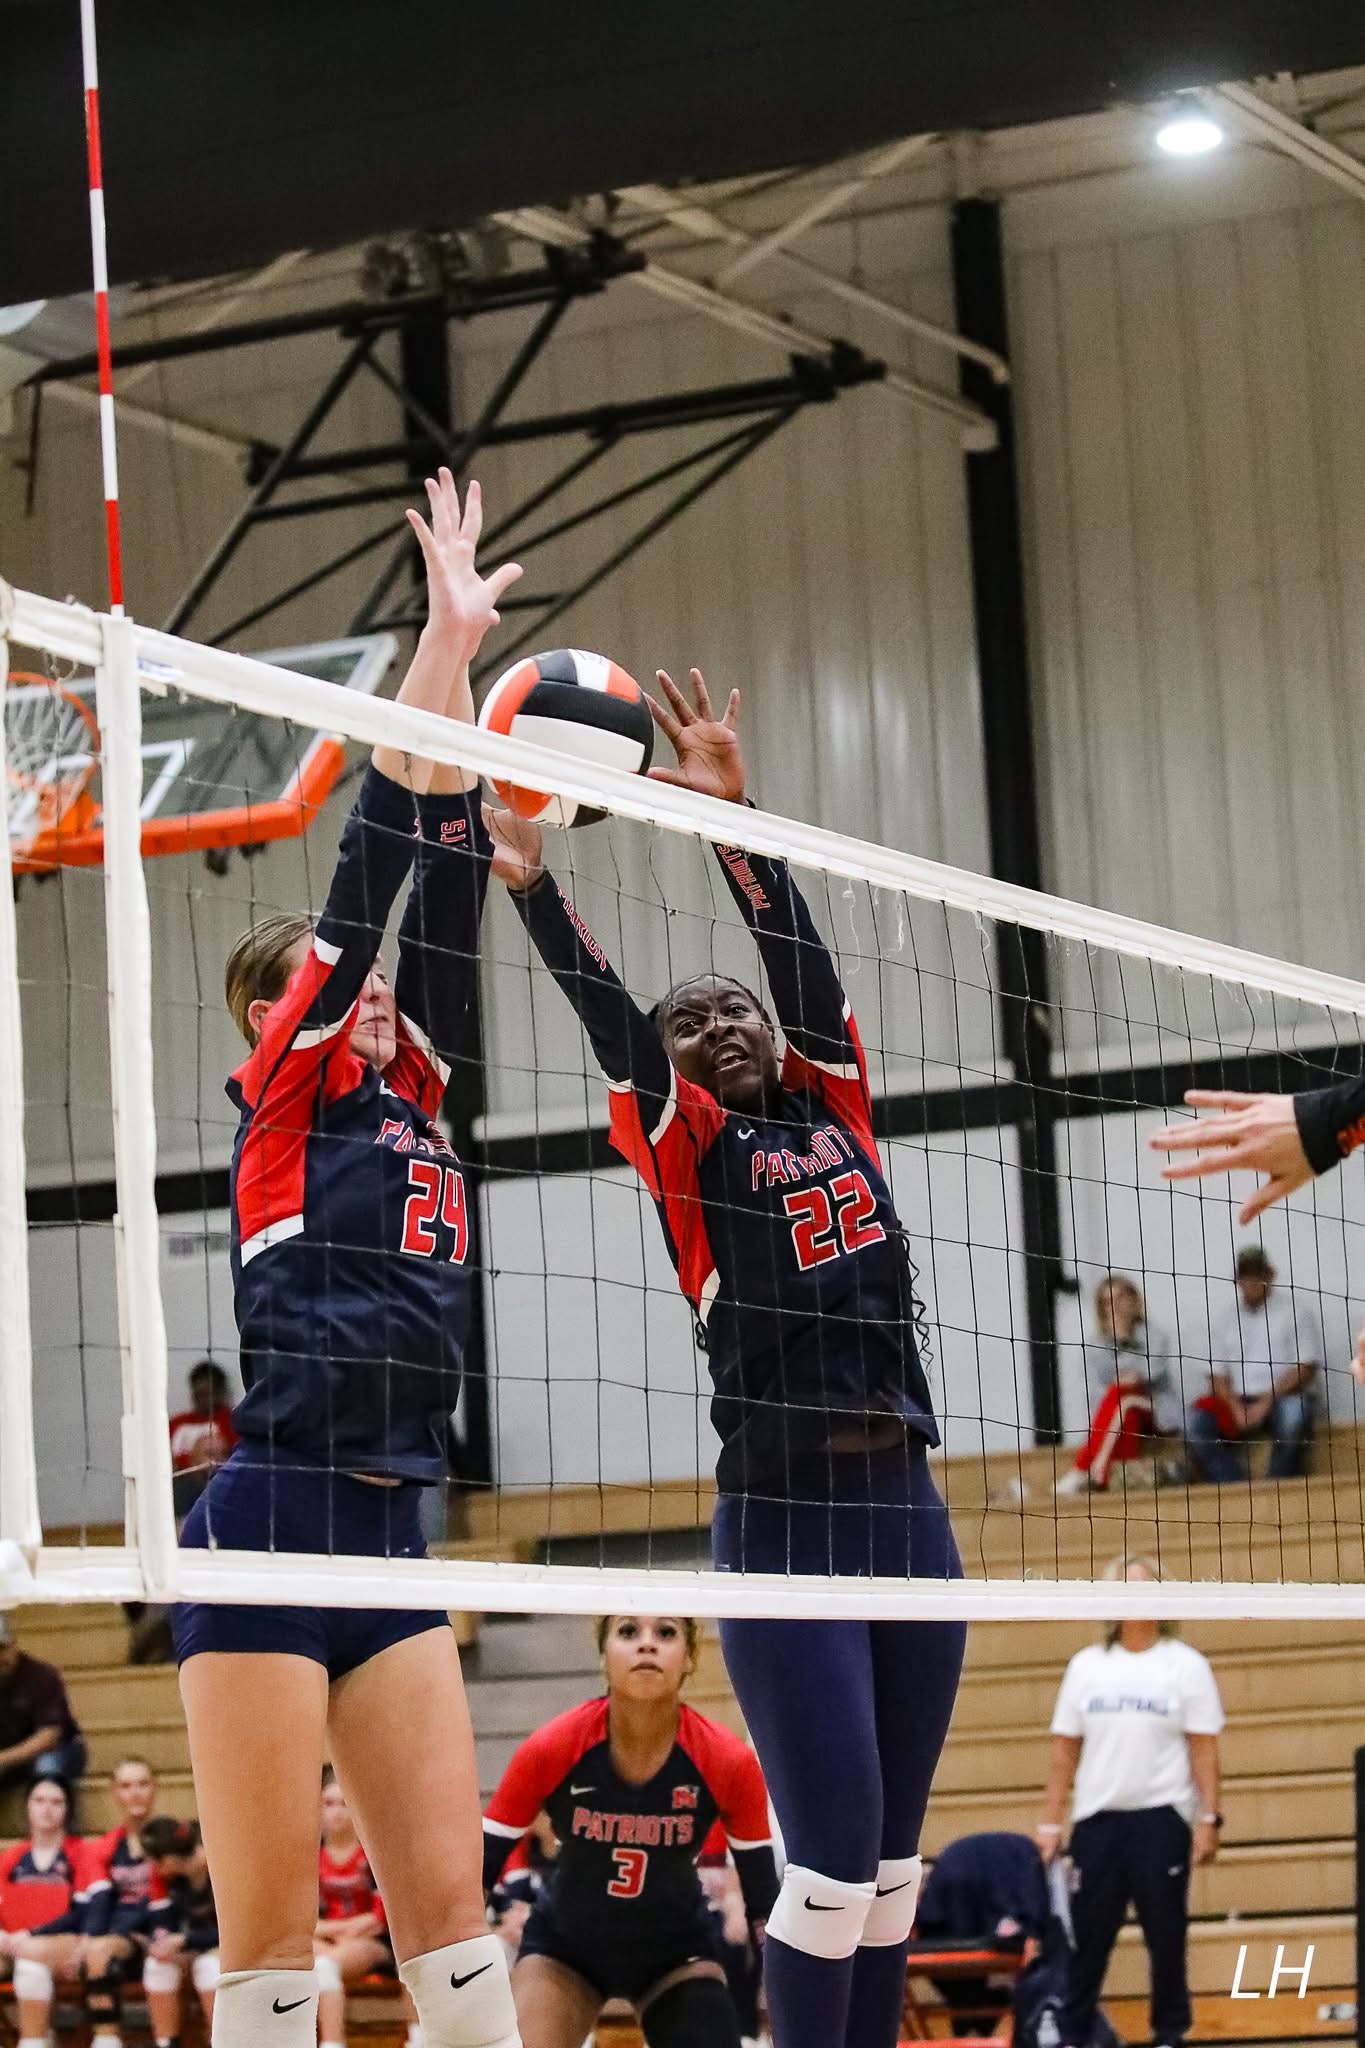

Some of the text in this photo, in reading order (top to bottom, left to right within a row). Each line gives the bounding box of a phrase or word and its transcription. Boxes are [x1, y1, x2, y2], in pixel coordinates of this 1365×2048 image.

[400, 1158, 468, 1265] 24
[782, 1169, 887, 1271] 22
[572, 1806, 694, 1846] PATRIOTS
[607, 1847, 648, 1899] 3
